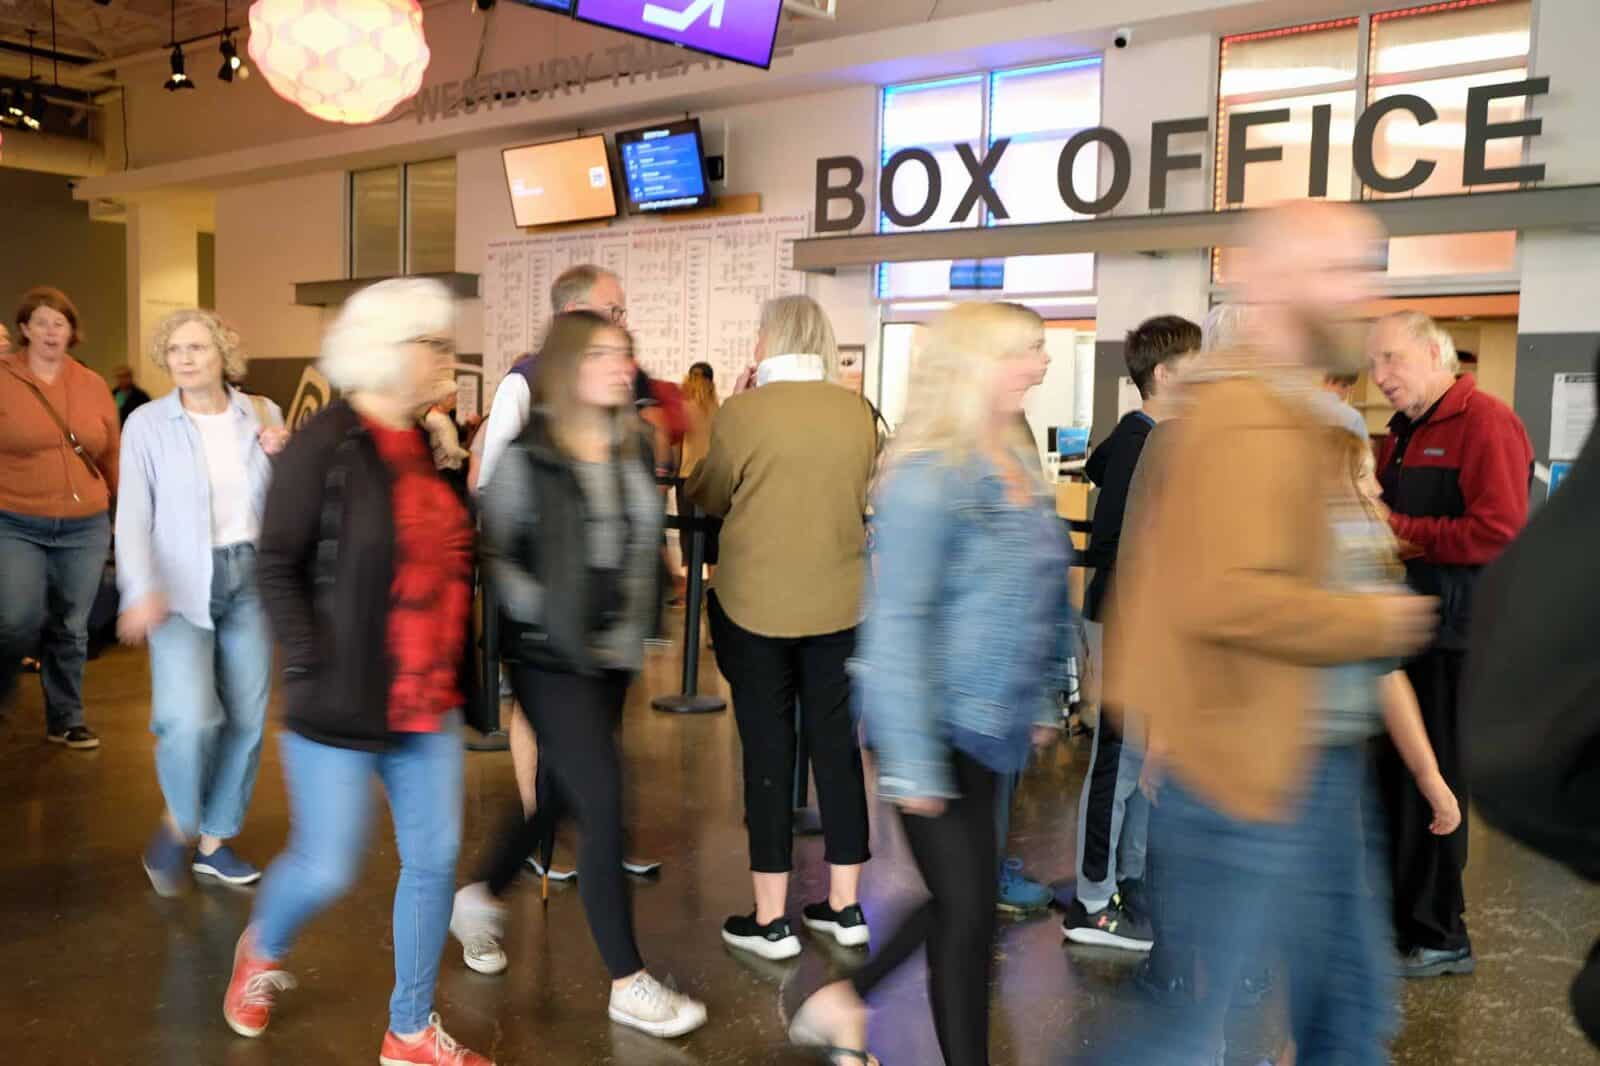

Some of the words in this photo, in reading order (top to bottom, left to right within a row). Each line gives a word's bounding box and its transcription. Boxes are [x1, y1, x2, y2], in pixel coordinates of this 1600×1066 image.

[414, 51, 594, 125] WESTBURY
[815, 138, 1011, 233] BOX
[1057, 77, 1549, 214] OFFICE
